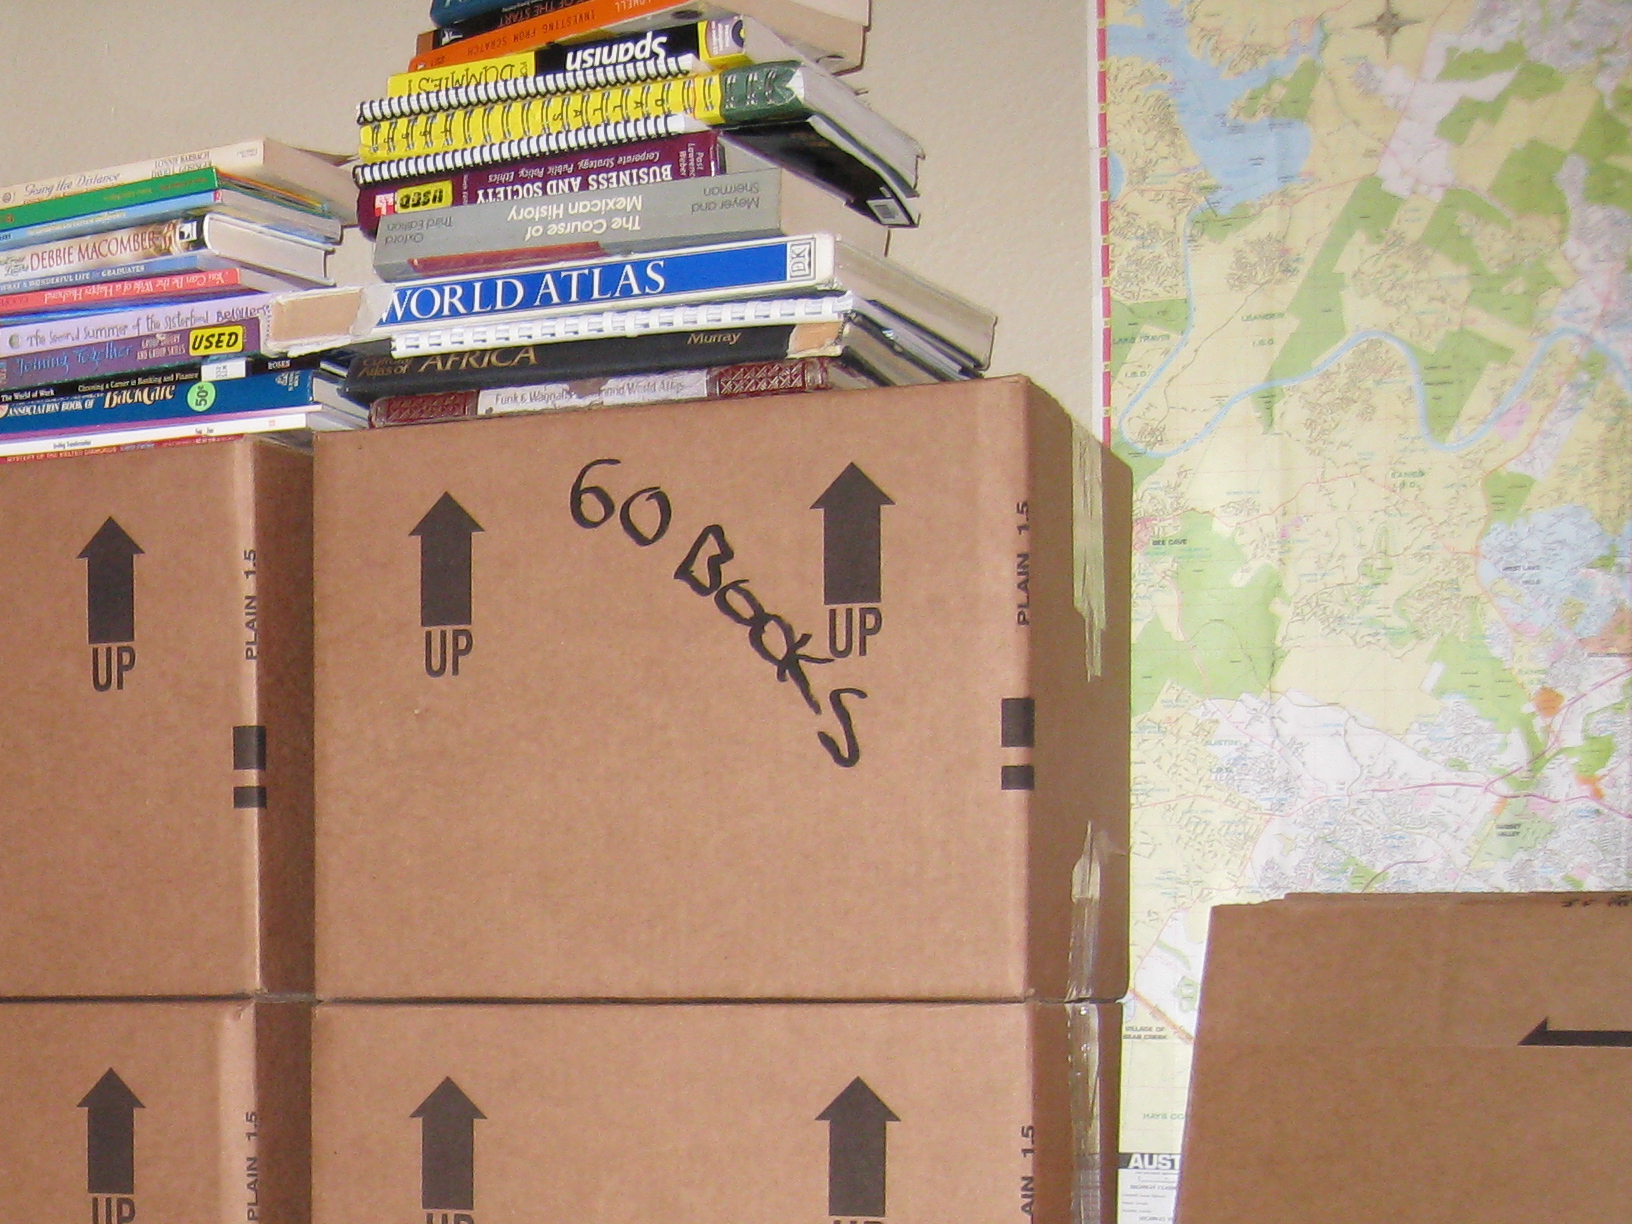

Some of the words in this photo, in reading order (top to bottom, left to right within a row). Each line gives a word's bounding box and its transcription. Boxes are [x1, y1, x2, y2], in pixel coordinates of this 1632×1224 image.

[566, 31, 667, 70] Spanish
[476, 181, 543, 204] SOCIETY
[547, 176, 581, 195] AND
[588, 164, 672, 191] BUSINESS
[507, 204, 564, 222] History
[568, 195, 643, 217] Mexican
[524, 227, 543, 241] of
[548, 218, 607, 236] Course
[611, 216, 641, 231] The
[30, 247, 74, 271] DEBBIE
[78, 232, 157, 263] MACOMBER
[379, 276, 525, 325] WORLD
[534, 260, 669, 308] ATLAS
[191, 331, 238, 350] USED
[687, 330, 742, 345] Murray
[419, 346, 538, 372] AFRICA
[8, 402, 60, 417] ASSOCIATION
[62, 400, 82, 411] BOOK
[84, 399, 96, 410] OF
[1016, 500, 1030, 536] 1.5
[243, 548, 257, 579] 1.5
[1017, 552, 1031, 627] PLAIN
[244, 594, 257, 661] PLAIN
[569, 458, 672, 547] 60
[674, 523, 868, 768] BOOKS
[827, 606, 883, 658] UP
[424, 628, 473, 678] UP
[91, 645, 136, 692] UP
[245, 1110, 258, 1140] 1.5
[1020, 1124, 1034, 1158] 1.5
[1128, 1154, 1180, 1169] AUST
[246, 1156, 259, 1221] PLAIN
